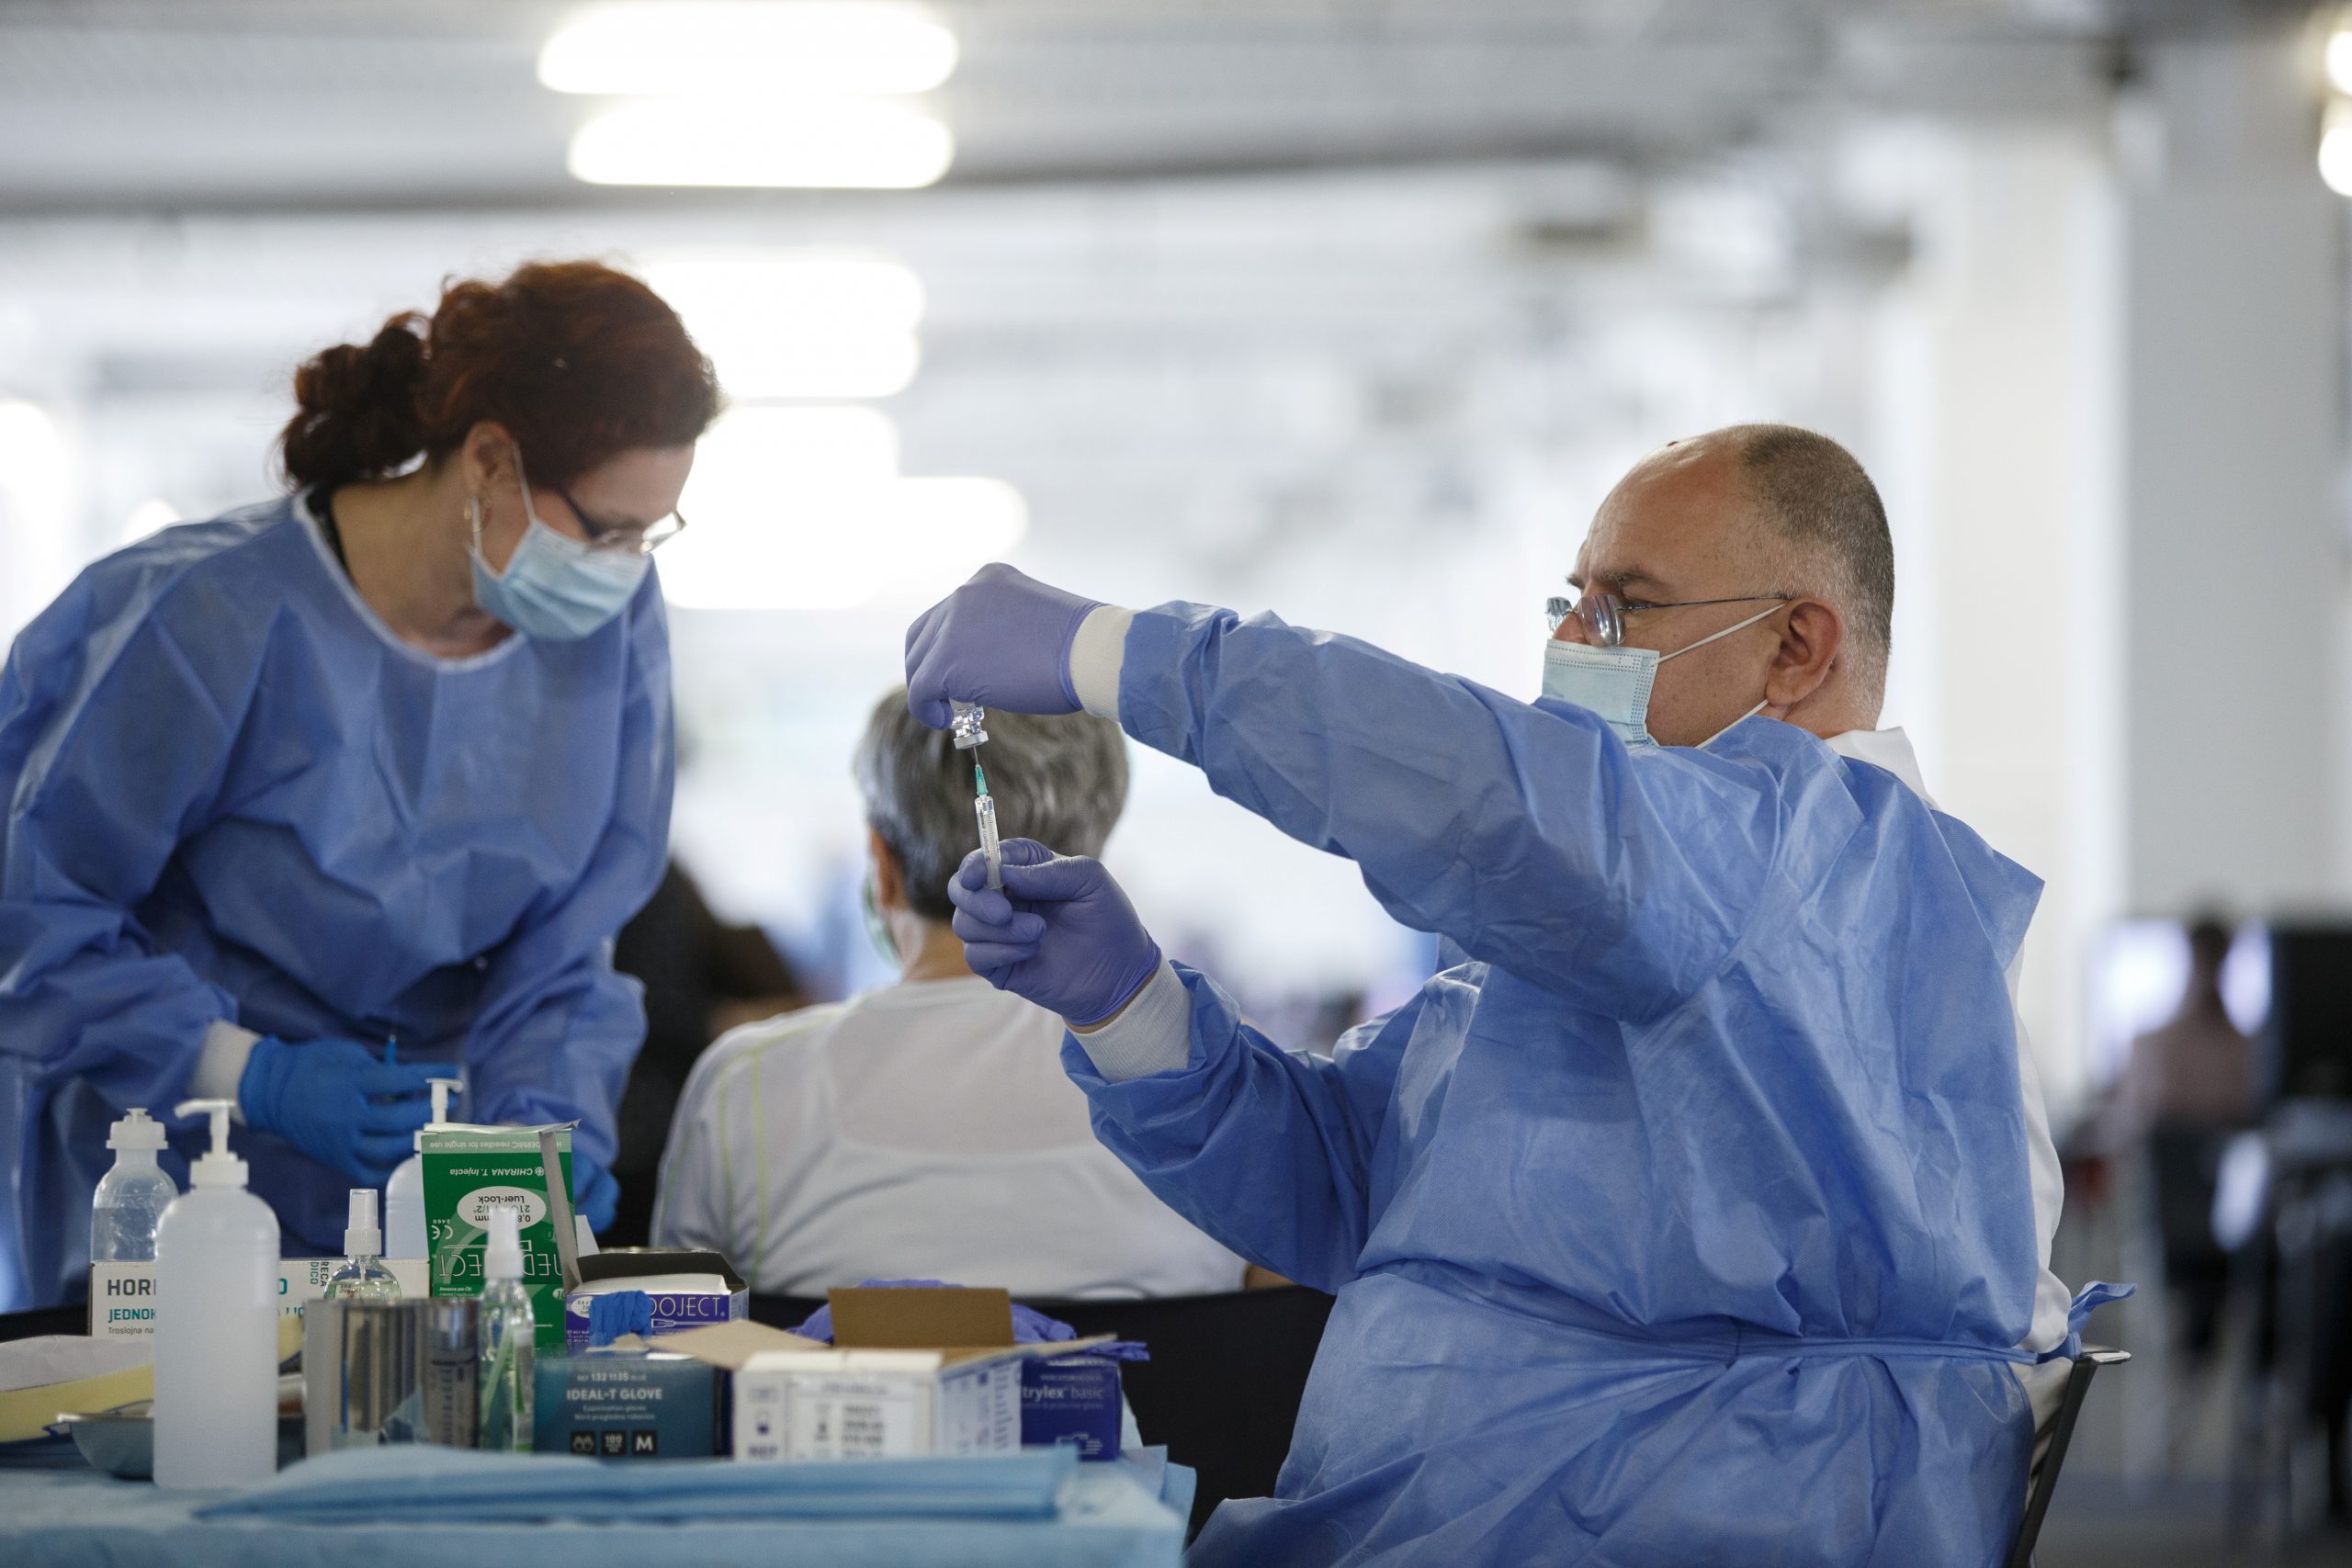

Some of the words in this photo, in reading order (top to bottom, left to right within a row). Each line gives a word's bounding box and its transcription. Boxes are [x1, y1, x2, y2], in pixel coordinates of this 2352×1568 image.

[445, 1140, 467, 1148] single
[468, 1140, 478, 1148] for
[480, 1140, 510, 1148] needles
[449, 1167, 479, 1176] Injecta
[480, 1168, 489, 1176] T.
[491, 1168, 533, 1176] CHIRANA
[478, 1195, 525, 1203] Luer-Lock
[107, 1279, 156, 1296] HOR
[107, 1326, 142, 1336] Troslojna
[566, 1388, 616, 1401] IDEAL-T
[619, 1388, 662, 1401] GLOVE
[1070, 1385, 1103, 1399] basic
[636, 1435, 654, 1451] M
